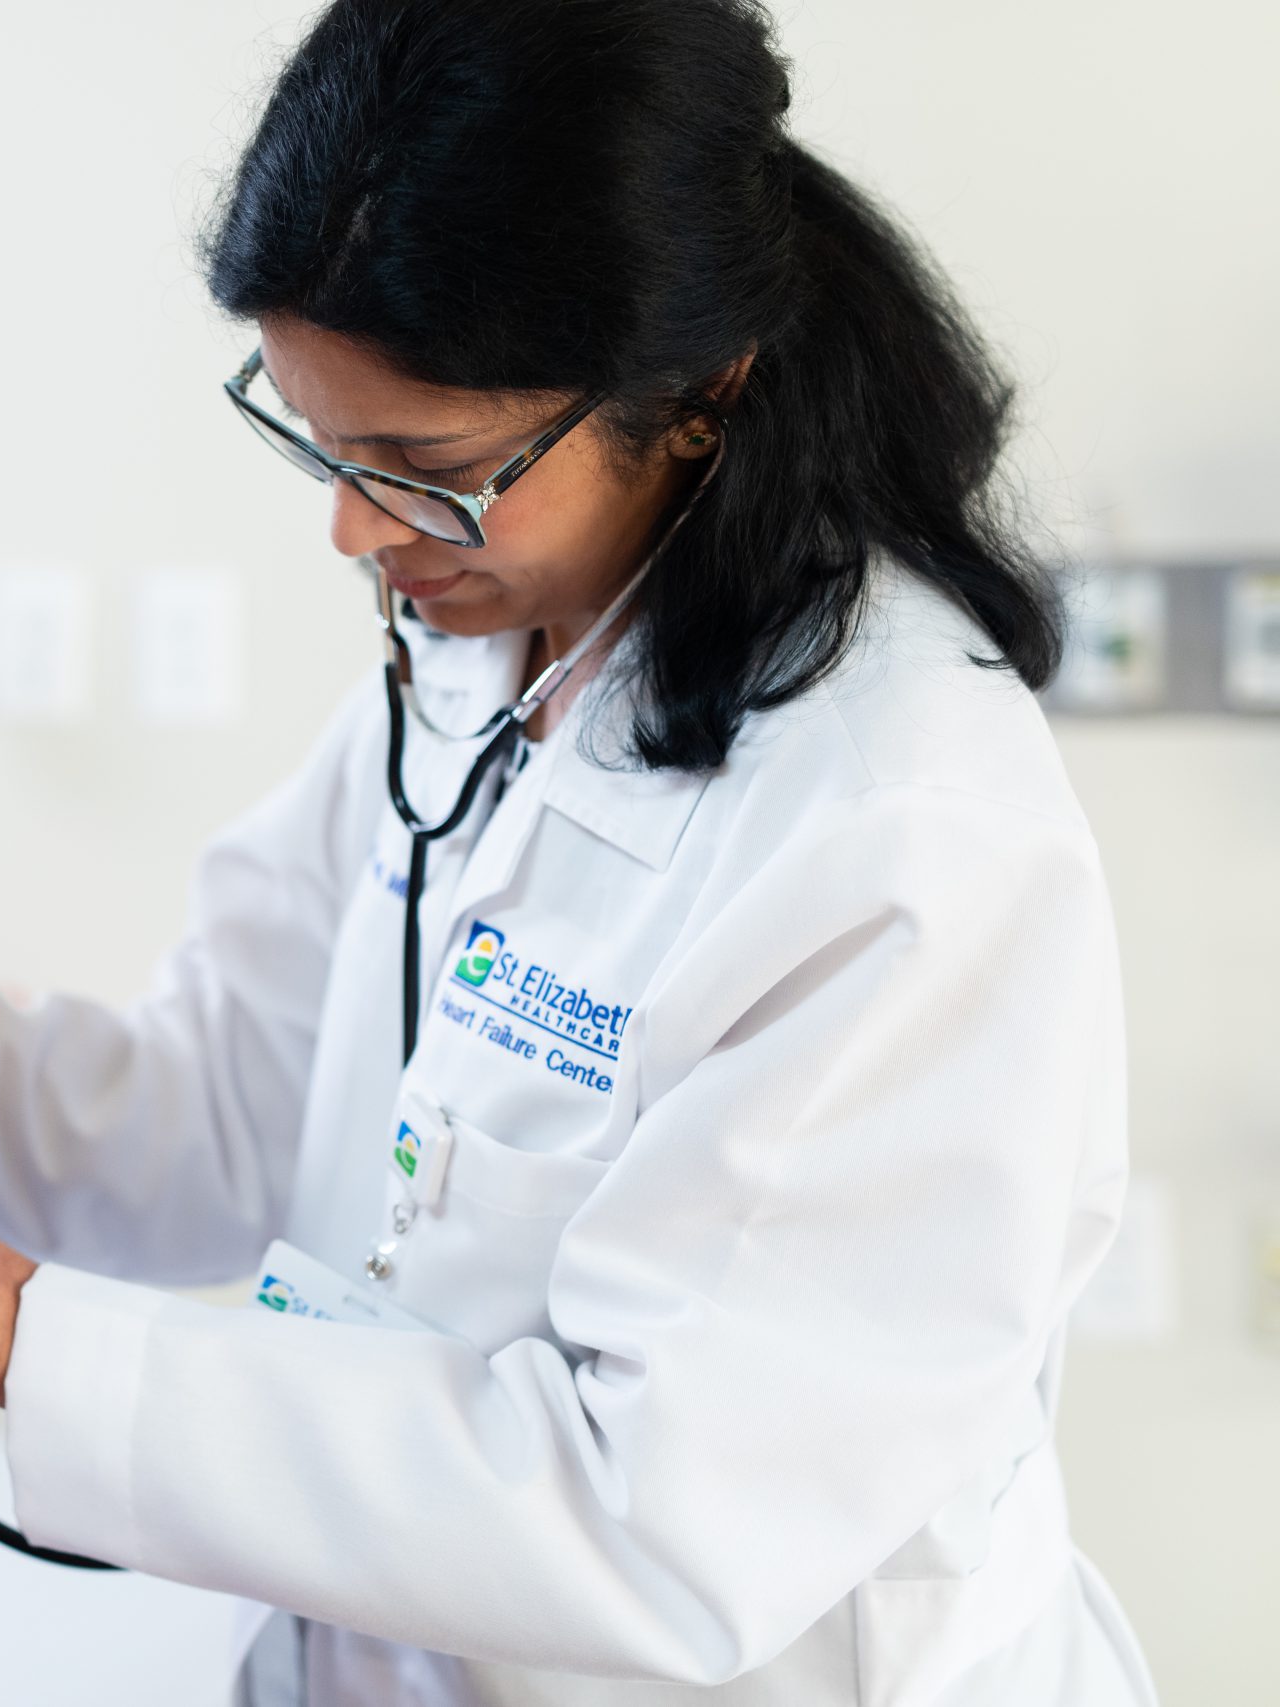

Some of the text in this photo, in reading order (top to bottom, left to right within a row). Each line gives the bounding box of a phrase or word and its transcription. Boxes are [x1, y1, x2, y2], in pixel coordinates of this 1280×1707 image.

[478, 1015, 537, 1060] Failure
[546, 1049, 613, 1095] Cente
[510, 994, 620, 1053] HEALTHCAR
